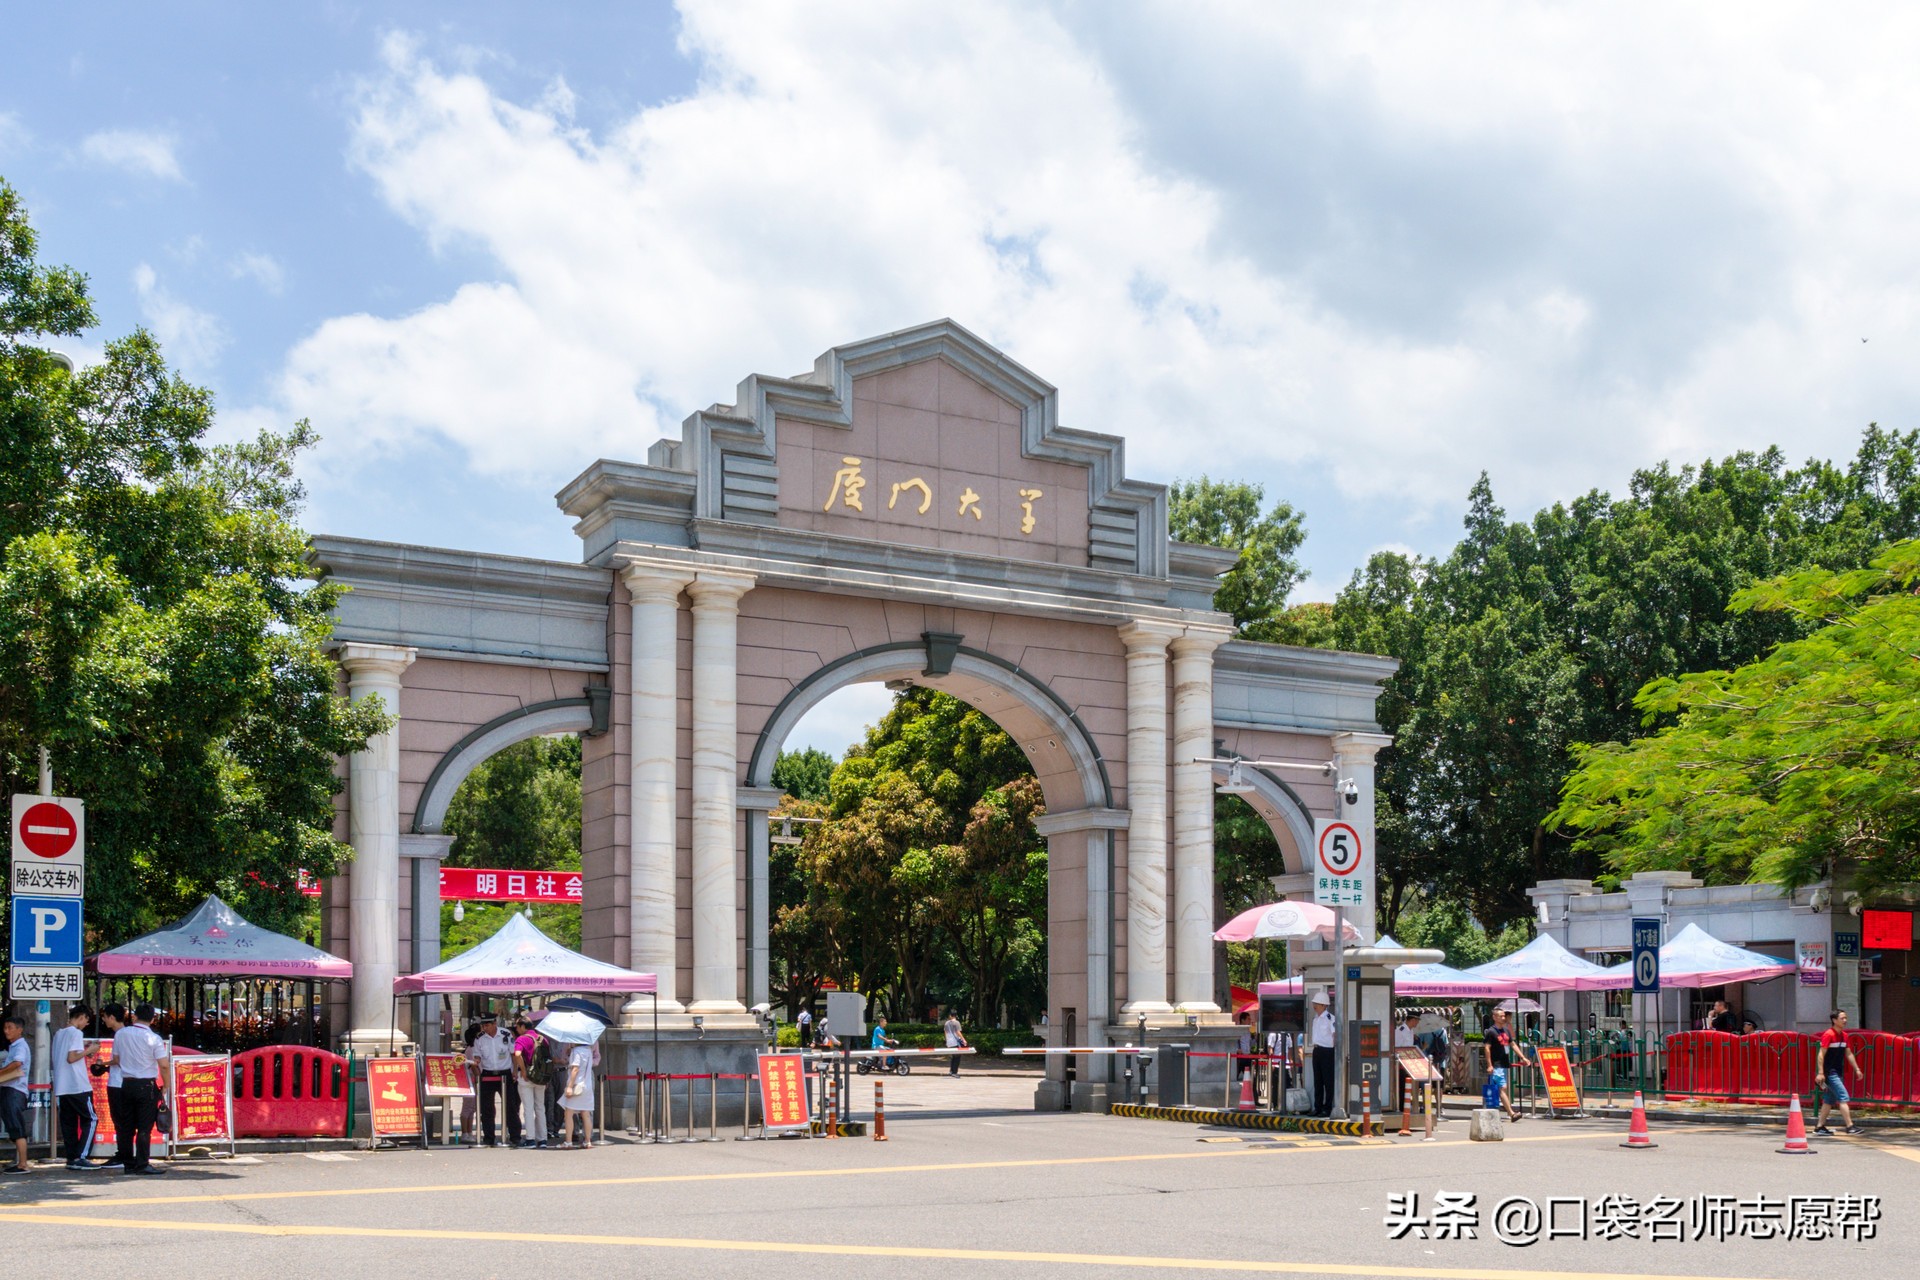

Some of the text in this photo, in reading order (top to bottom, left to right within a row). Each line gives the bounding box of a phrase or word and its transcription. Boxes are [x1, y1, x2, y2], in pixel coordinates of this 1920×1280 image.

[1332, 835, 1348, 865] 5
[16, 868, 80, 890] 除公交车外
[1319, 878, 1362, 891] 保持车距
[1319, 893, 1362, 905] 一车一杆
[30, 907, 67, 954] P
[1635, 928, 1658, 948] 地下通道
[1839, 943, 1852, 953] 422
[1801, 956, 1824, 968] 110
[14, 972, 79, 993] 公交车专用
[375, 1064, 409, 1074] 温馨提示
[1362, 1062, 1373, 1079] P
[784, 1060, 800, 1121] 严禁黄牛黑车
